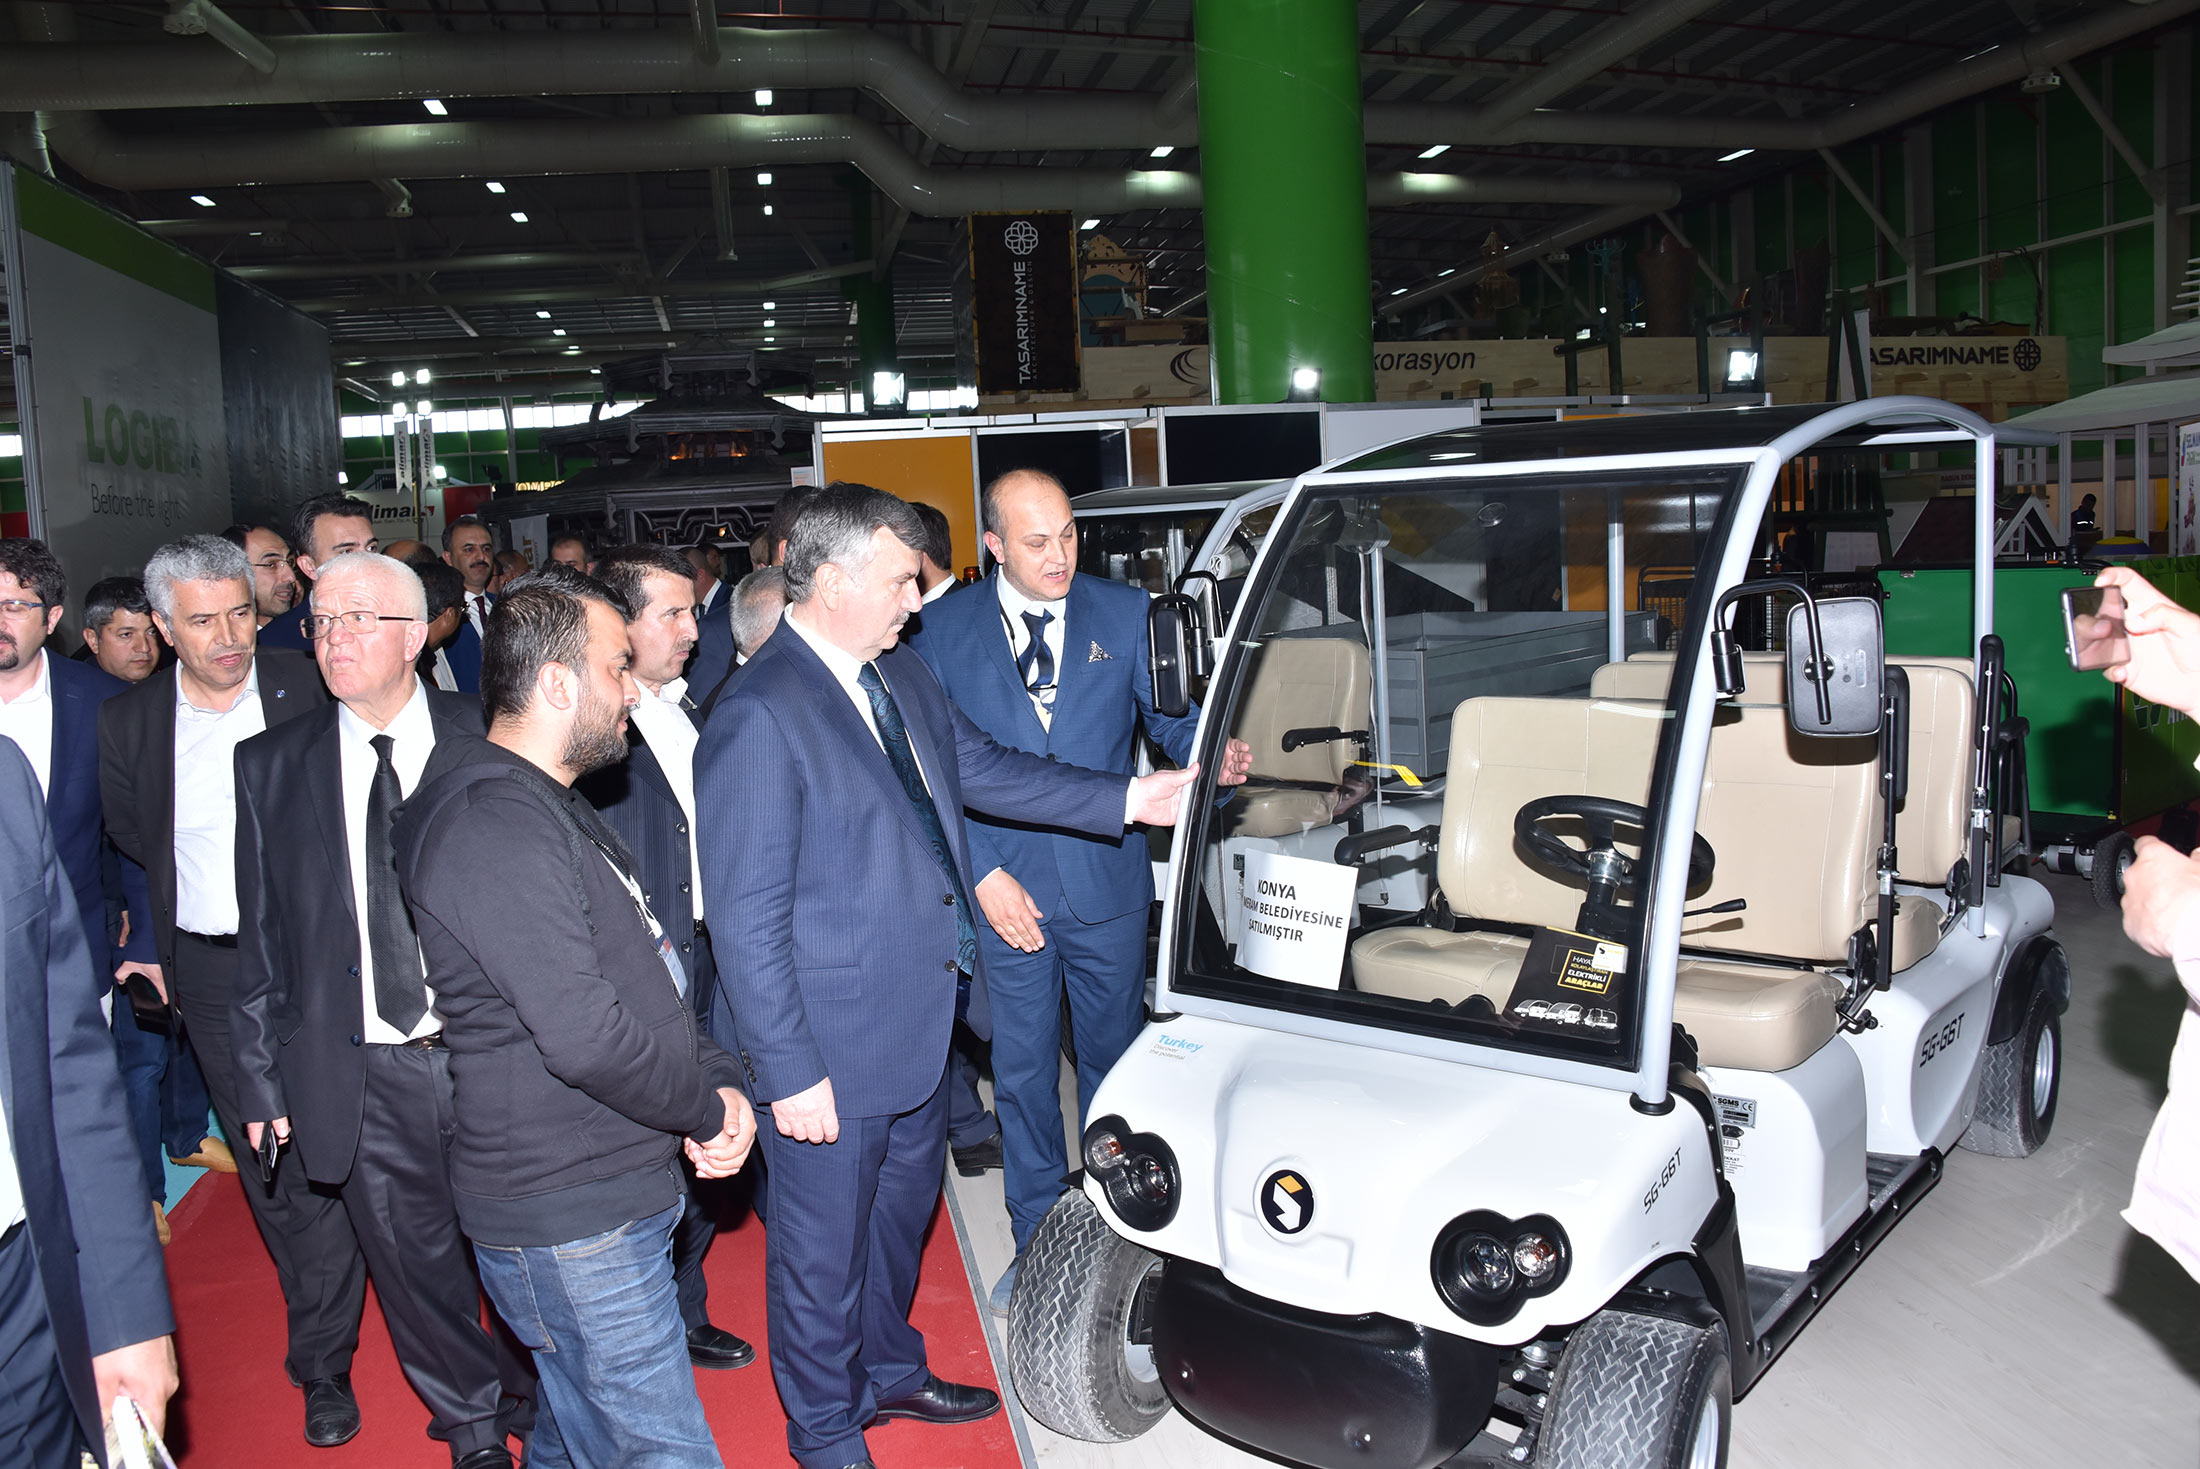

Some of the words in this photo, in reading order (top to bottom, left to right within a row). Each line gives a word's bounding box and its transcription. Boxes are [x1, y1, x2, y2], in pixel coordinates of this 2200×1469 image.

[1014, 261, 1031, 384] TASARIMNAME
[1029, 310, 1038, 380] ARCHITECTURE
[1870, 346, 2009, 366] ASARIMNAME
[398, 437, 406, 479] alimar
[91, 483, 133, 517] Before
[135, 489, 155, 518] the
[1257, 879, 1297, 901] KONYA
[1259, 902, 1344, 929] BELEDİYESİNE
[1248, 918, 1303, 941] SATILMIŞTIR
[1572, 955, 1592, 966] HAYA
[1564, 976, 1604, 990] ARAÇLAR
[1567, 968, 1607, 983] ELEKTRİKLİ
[1159, 1035, 1204, 1053] Turkey
[1920, 1012, 1965, 1068] SG-G6T
[1643, 1146, 1681, 1215] SG-G6T
